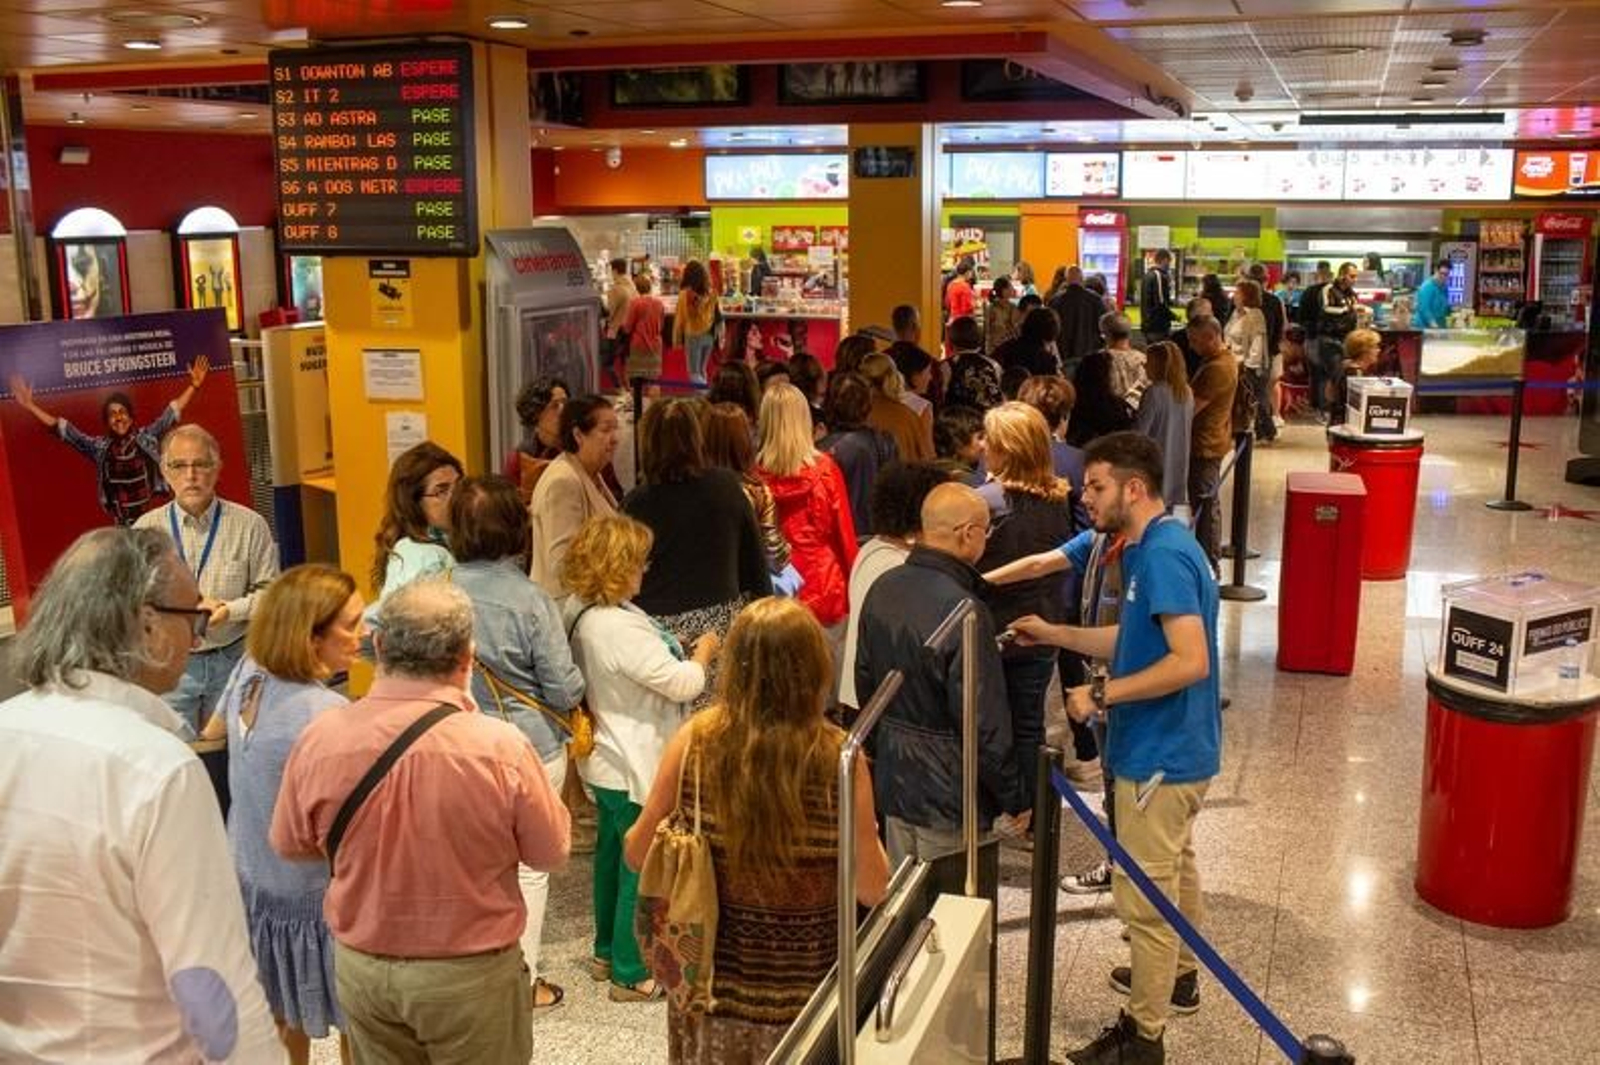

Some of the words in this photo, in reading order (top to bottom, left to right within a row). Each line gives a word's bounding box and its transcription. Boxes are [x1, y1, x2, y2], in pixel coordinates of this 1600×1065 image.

[274, 67, 291, 81] S1
[373, 63, 393, 78] AB
[401, 60, 459, 75] ESPERE
[275, 90, 294, 103] S2
[304, 90, 320, 103] IT
[329, 89, 340, 101] 2
[401, 85, 460, 100] ESPERE
[277, 113, 296, 127] S3
[330, 111, 378, 125] ASTRA
[411, 108, 451, 123] PASE
[278, 136, 297, 149] S4
[367, 134, 396, 148] LAS
[412, 132, 451, 146] PASE
[280, 158, 299, 172] S5
[306, 156, 380, 171] MIENTRAS
[414, 155, 452, 170] PASE
[281, 181, 300, 194] S6
[308, 181, 318, 194] A
[361, 179, 398, 194] METR
[327, 202, 337, 217] 7
[416, 201, 453, 216] PASE
[417, 224, 455, 239] PASE
[64, 360, 102, 378] BRUCE
[104, 351, 176, 373] SPRINGSTEEN
[1488, 641, 1504, 657] 24
